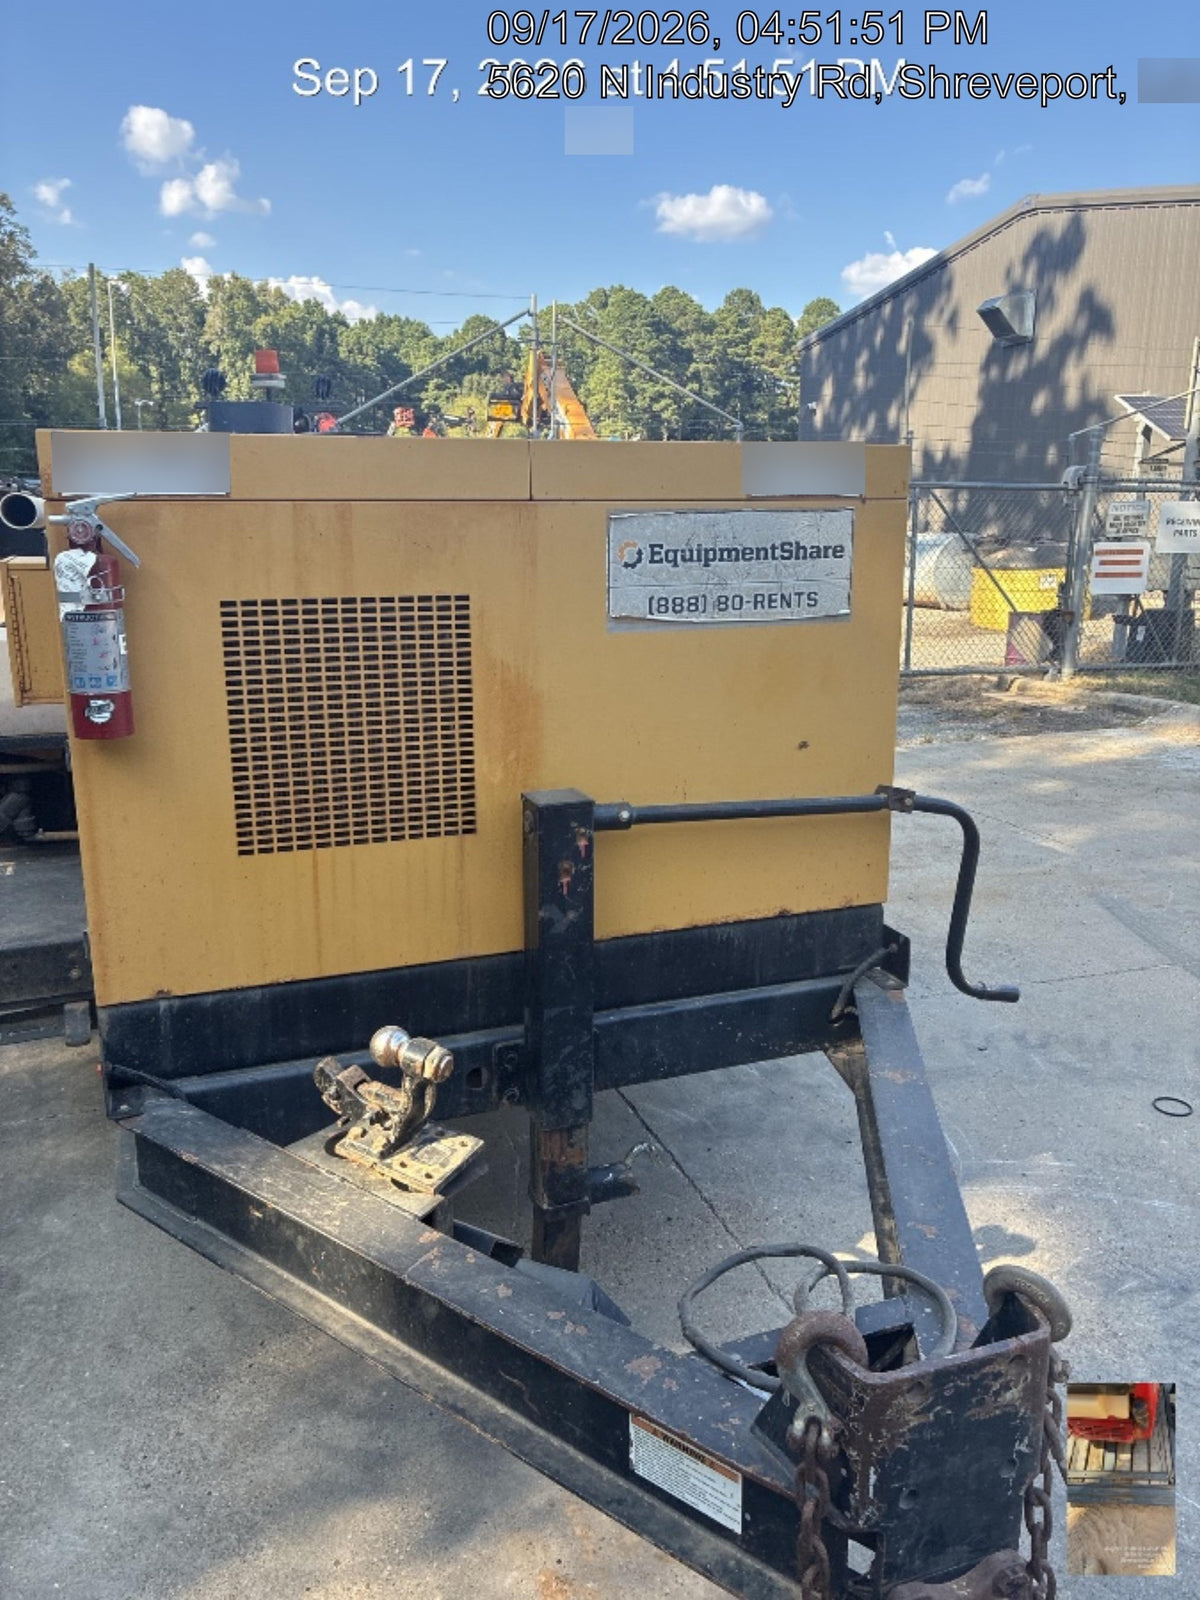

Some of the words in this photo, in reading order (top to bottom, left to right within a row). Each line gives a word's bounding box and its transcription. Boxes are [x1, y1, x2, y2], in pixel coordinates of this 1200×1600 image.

[648, 541, 845, 568] EquipmentShare
[648, 594, 707, 616] (888)
[717, 591, 819, 613] 80-RENTS
